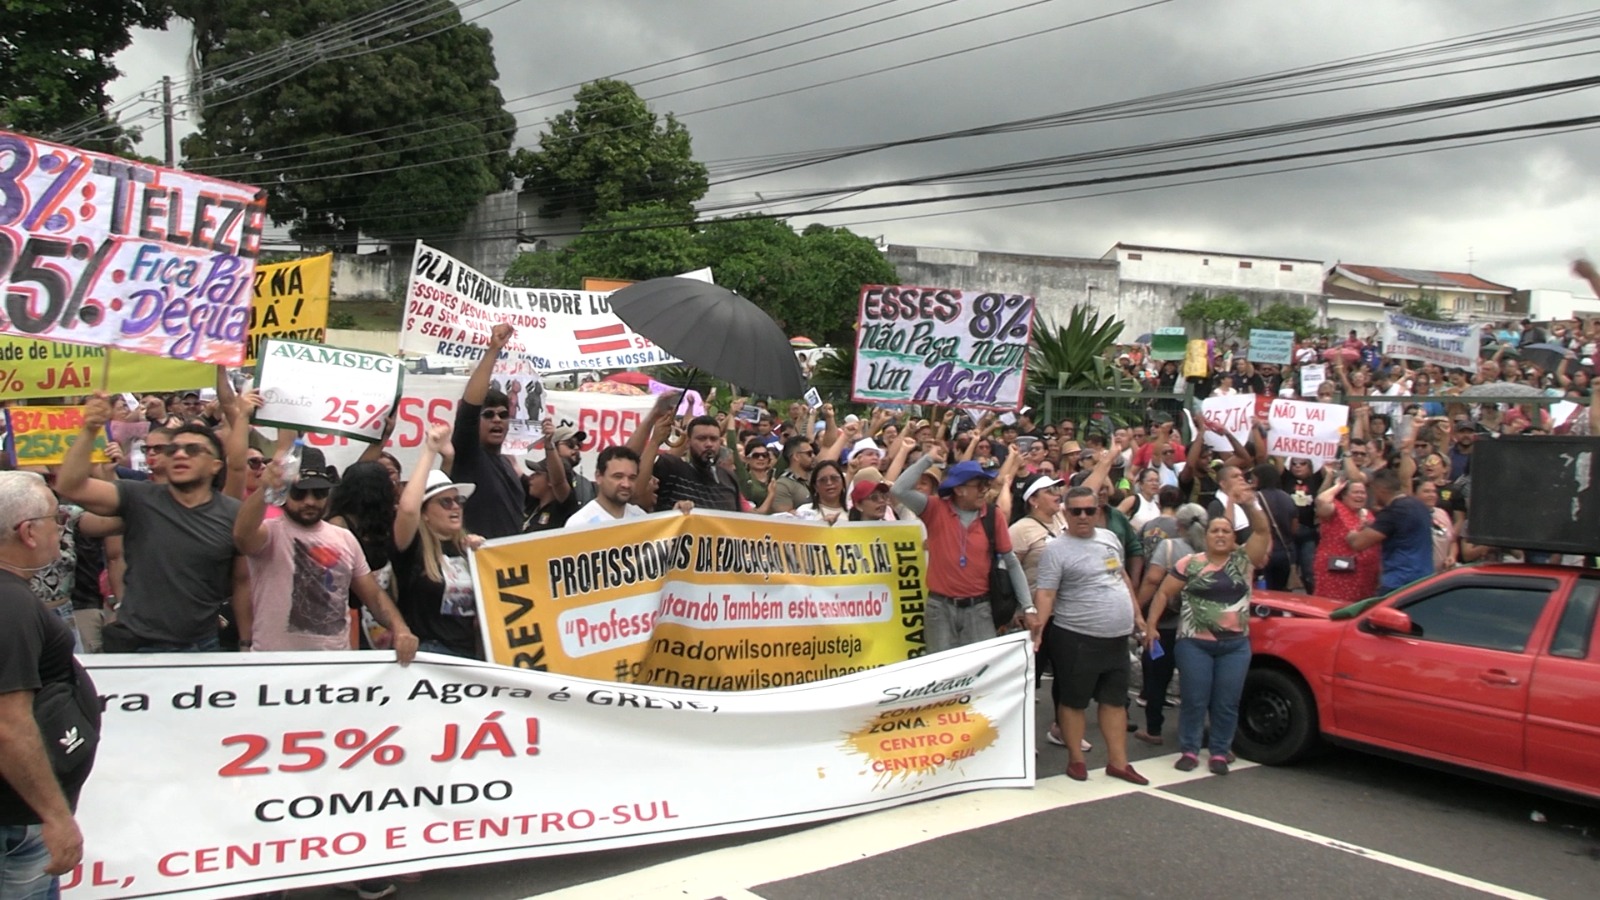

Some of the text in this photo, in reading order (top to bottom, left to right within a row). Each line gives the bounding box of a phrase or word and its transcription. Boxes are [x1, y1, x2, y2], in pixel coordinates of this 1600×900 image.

[271, 265, 303, 296] NA
[456, 266, 524, 310] ESTADUAL
[526, 291, 582, 315] PADRE
[865, 288, 1033, 341] ESSES 8%
[420, 322, 453, 340] SEM
[29, 341, 48, 360] de
[271, 344, 393, 373] AVAMSEG
[617, 351, 655, 366] NOSSA
[37, 362, 91, 390] JÁ!
[322, 396, 390, 430] 25%
[1274, 403, 1296, 419] NÃO
[1306, 407, 1326, 421] VAI
[1292, 422, 1315, 436] TER
[695, 536, 713, 572] DA
[716, 535, 785, 580] EDUCAÇÃO
[723, 591, 783, 620] Também
[172, 685, 236, 709] de
[258, 683, 391, 707] Lutar,
[408, 678, 532, 704] Agora
[548, 687, 571, 702] é
[880, 694, 971, 719] COMANDO
[218, 710, 541, 778] 25% JÁ!
[879, 732, 971, 752] CENTRO e
[871, 748, 976, 773] CENTRO-SUL
[255, 780, 513, 822] COMANDO
[157, 832, 367, 877] CENTRO
[386, 827, 407, 849] E
[422, 800, 679, 844] CENTRO-SUL
